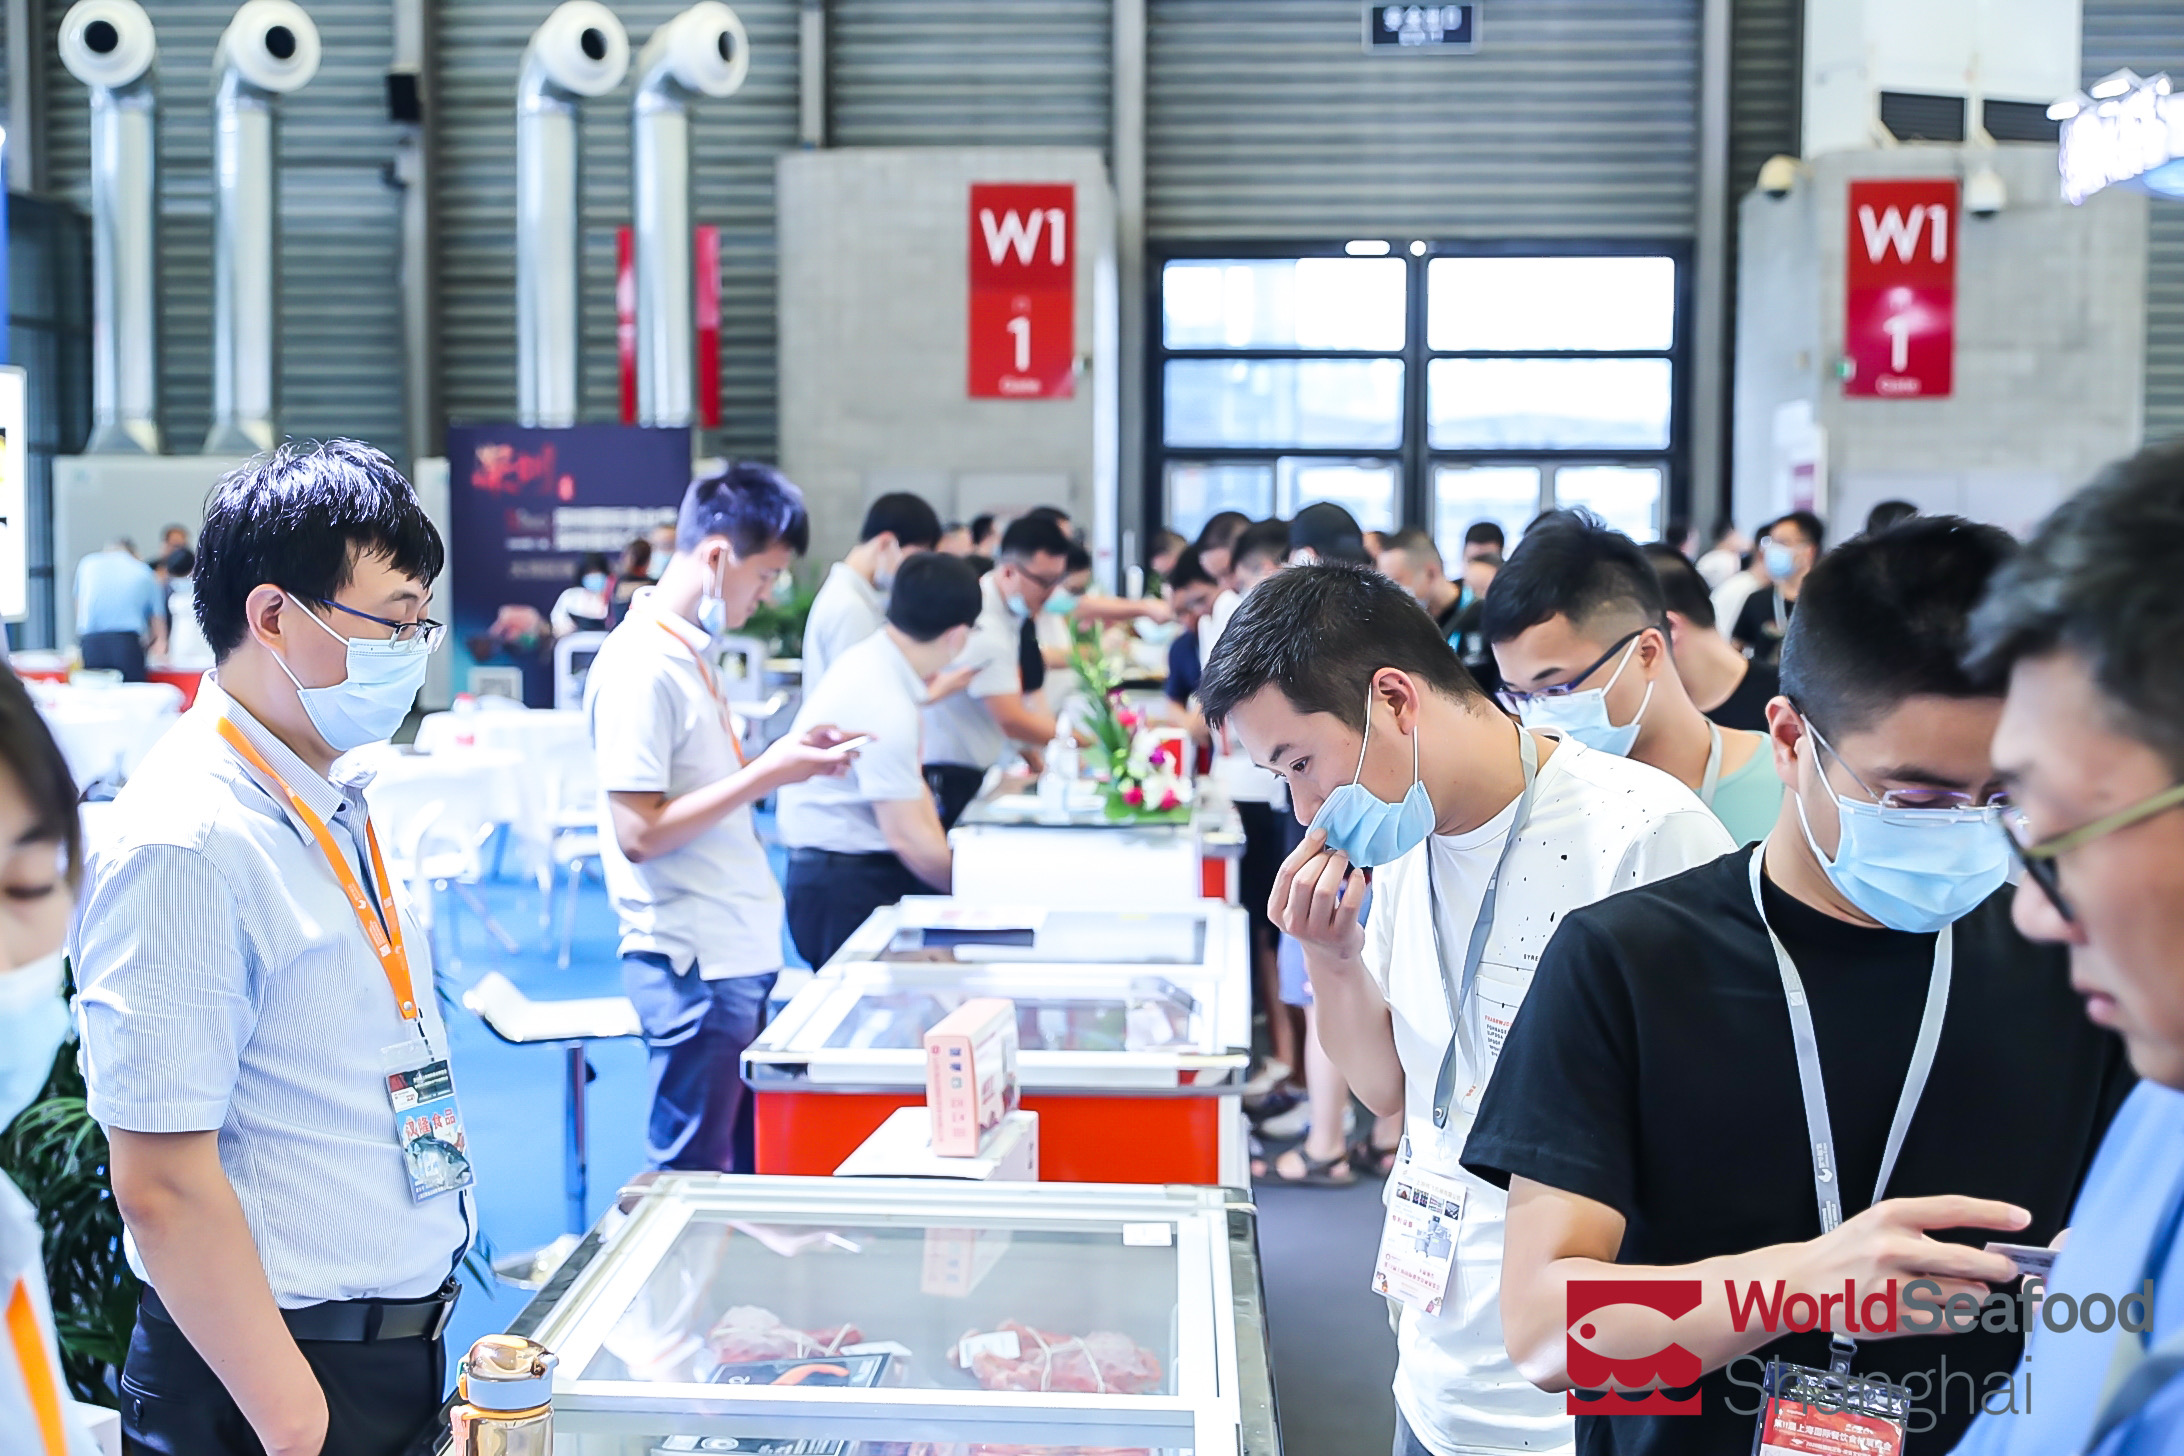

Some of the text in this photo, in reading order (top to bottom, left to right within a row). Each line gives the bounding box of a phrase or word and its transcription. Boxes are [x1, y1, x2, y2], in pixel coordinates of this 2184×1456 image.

[979, 207, 1066, 267] W1
[1858, 203, 1948, 264] W1
[1006, 316, 1031, 373] 1
[1883, 315, 1909, 373] 1
[405, 1108, 457, 1139] 汉隆食品
